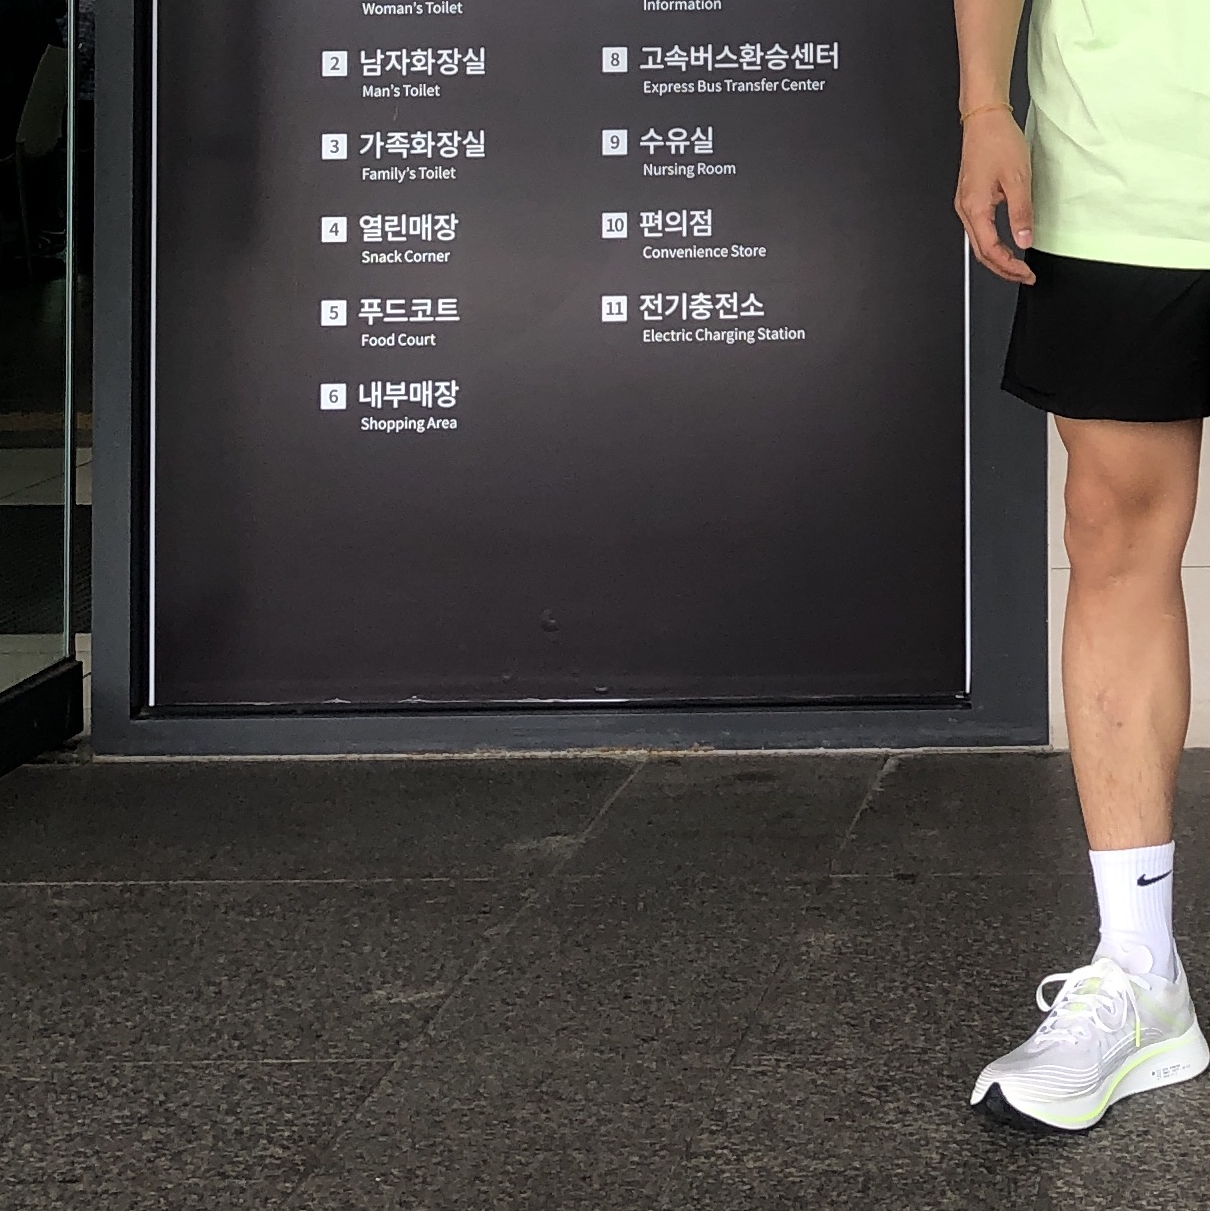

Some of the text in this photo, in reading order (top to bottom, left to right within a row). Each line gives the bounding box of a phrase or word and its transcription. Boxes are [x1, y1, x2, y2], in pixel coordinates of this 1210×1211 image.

[362, 1, 463, 15] Woman's Toilet
[330, 47, 486, 77] 2 남자화장실
[610, 41, 839, 72] 8 고속버스환승센터
[362, 84, 441, 98] Man's Toilet
[643, 78, 826, 96] Express Bus Transfer Center
[330, 129, 486, 160] 3 가족화장실
[610, 126, 714, 155] 9 수유실
[362, 166, 456, 183] Family's Toilet
[643, 162, 736, 178] Nursing Room
[328, 213, 459, 243] 4 열린매장
[606, 208, 713, 238] 10 편의점
[362, 249, 451, 264] Snack Corner
[642, 244, 767, 259] Convenience Store
[328, 297, 461, 325] 5 푸드코트
[606, 292, 765, 321] 11 전기충전소
[361, 332, 436, 347] Food Court
[642, 326, 806, 345] Electric Charging Station
[328, 379, 459, 410] 6 내부매장
[361, 414, 458, 433] Shopping Area
